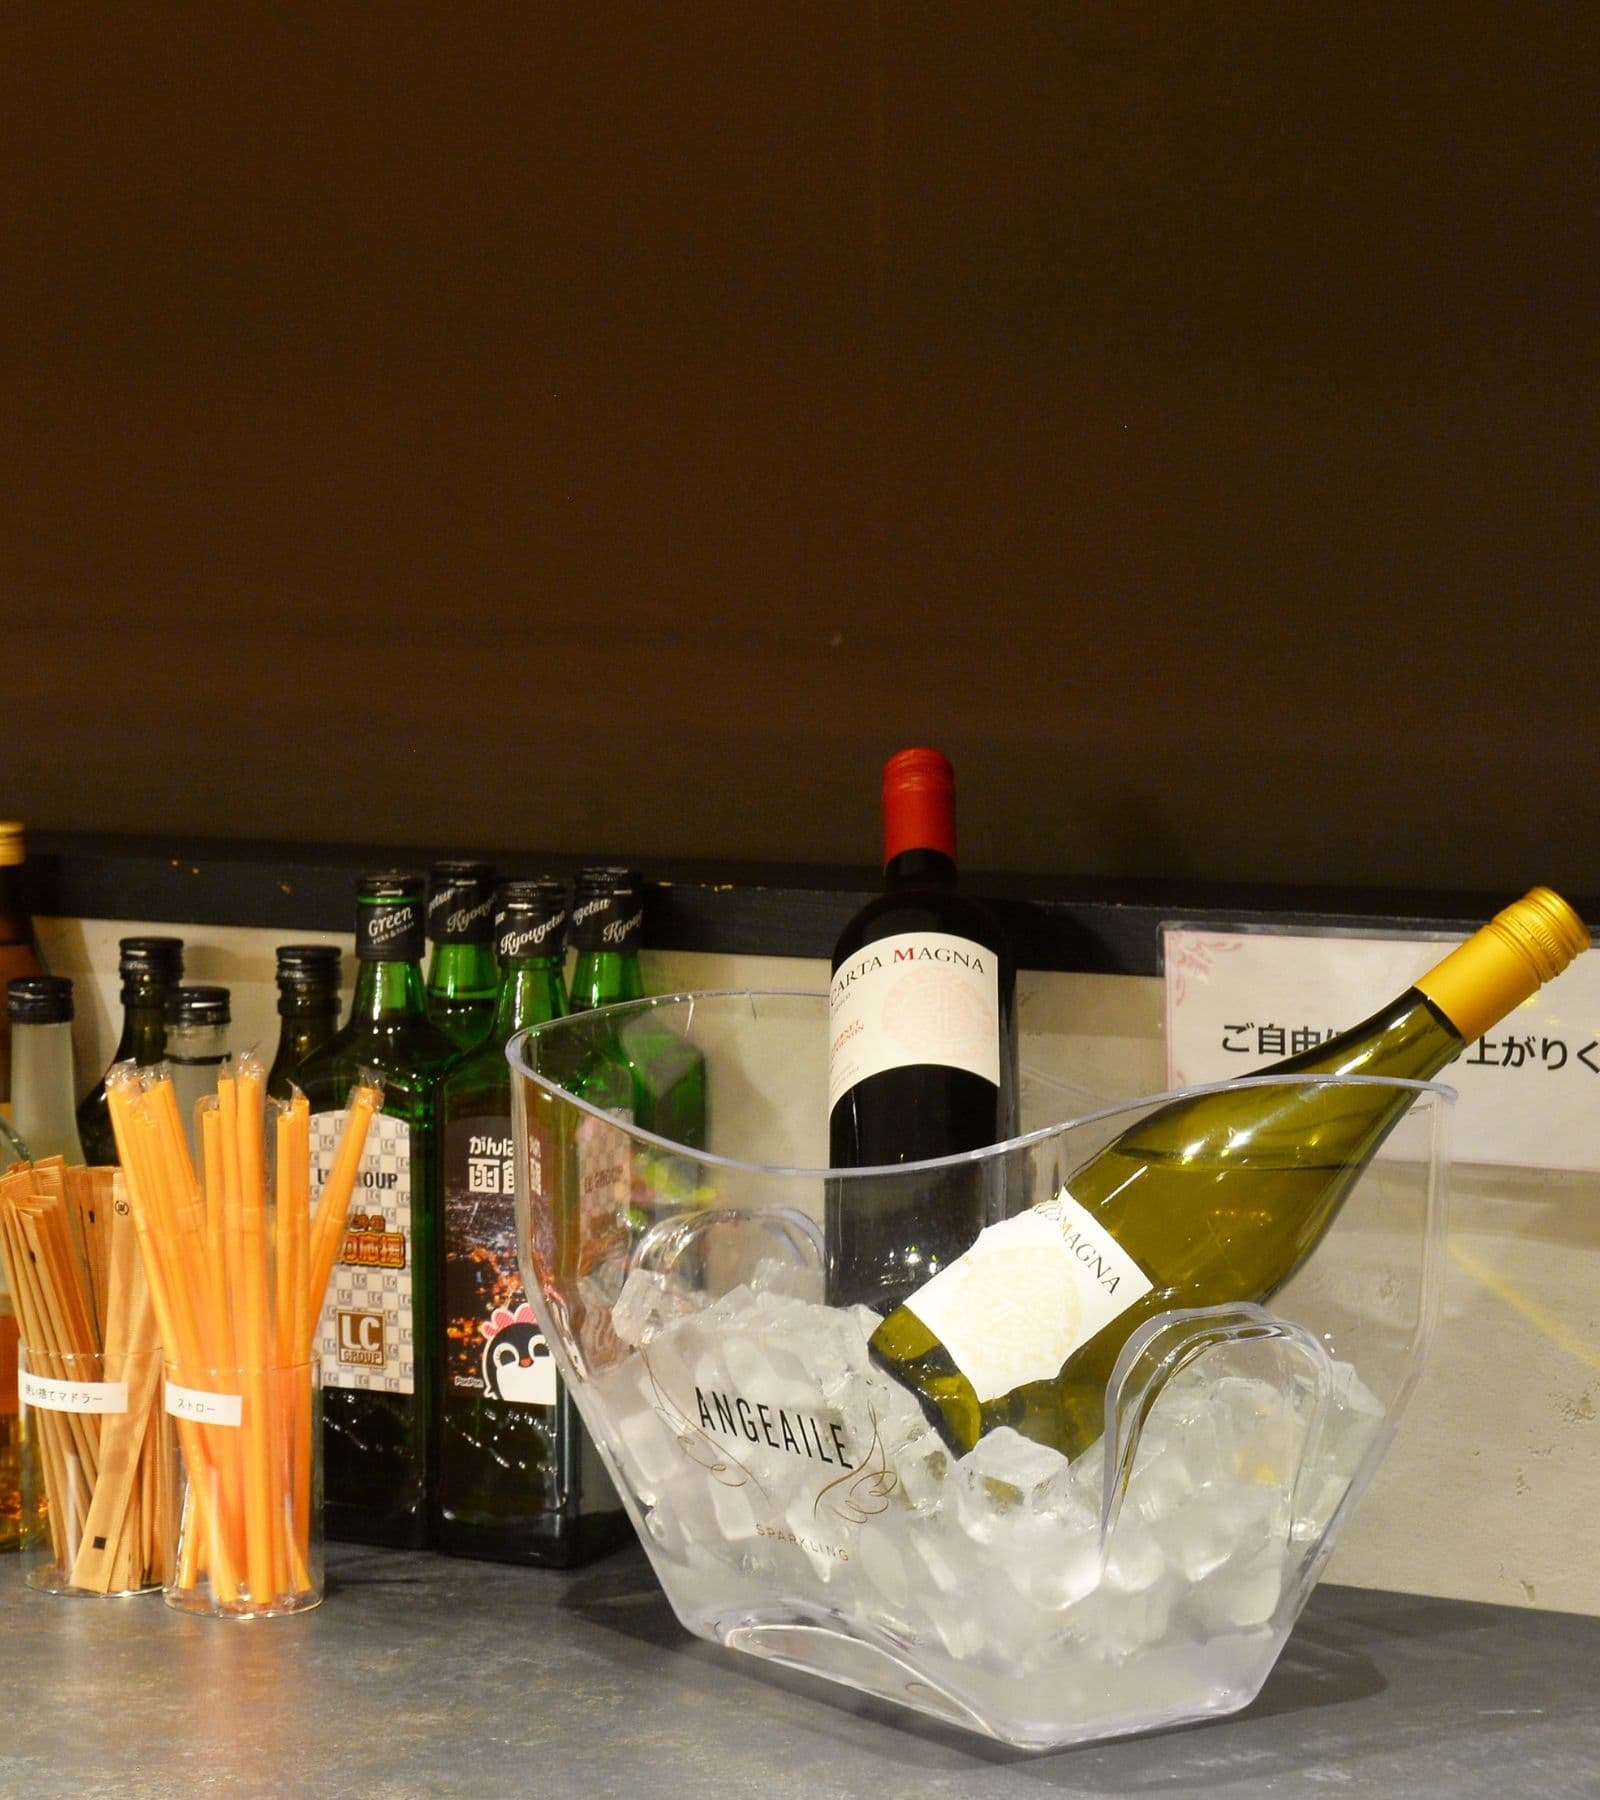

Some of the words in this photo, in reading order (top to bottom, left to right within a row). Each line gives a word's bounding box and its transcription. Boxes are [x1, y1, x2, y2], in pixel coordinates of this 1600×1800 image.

[368, 906, 414, 937] Green
[893, 946, 985, 975] MAGNA
[341, 1314, 381, 1351] LC
[342, 1350, 381, 1364] GROUP
[177, 1398, 216, 1414] ストロー
[695, 1386, 854, 1470] ANGEAILE
[755, 1523, 849, 1562] SPARKLING
